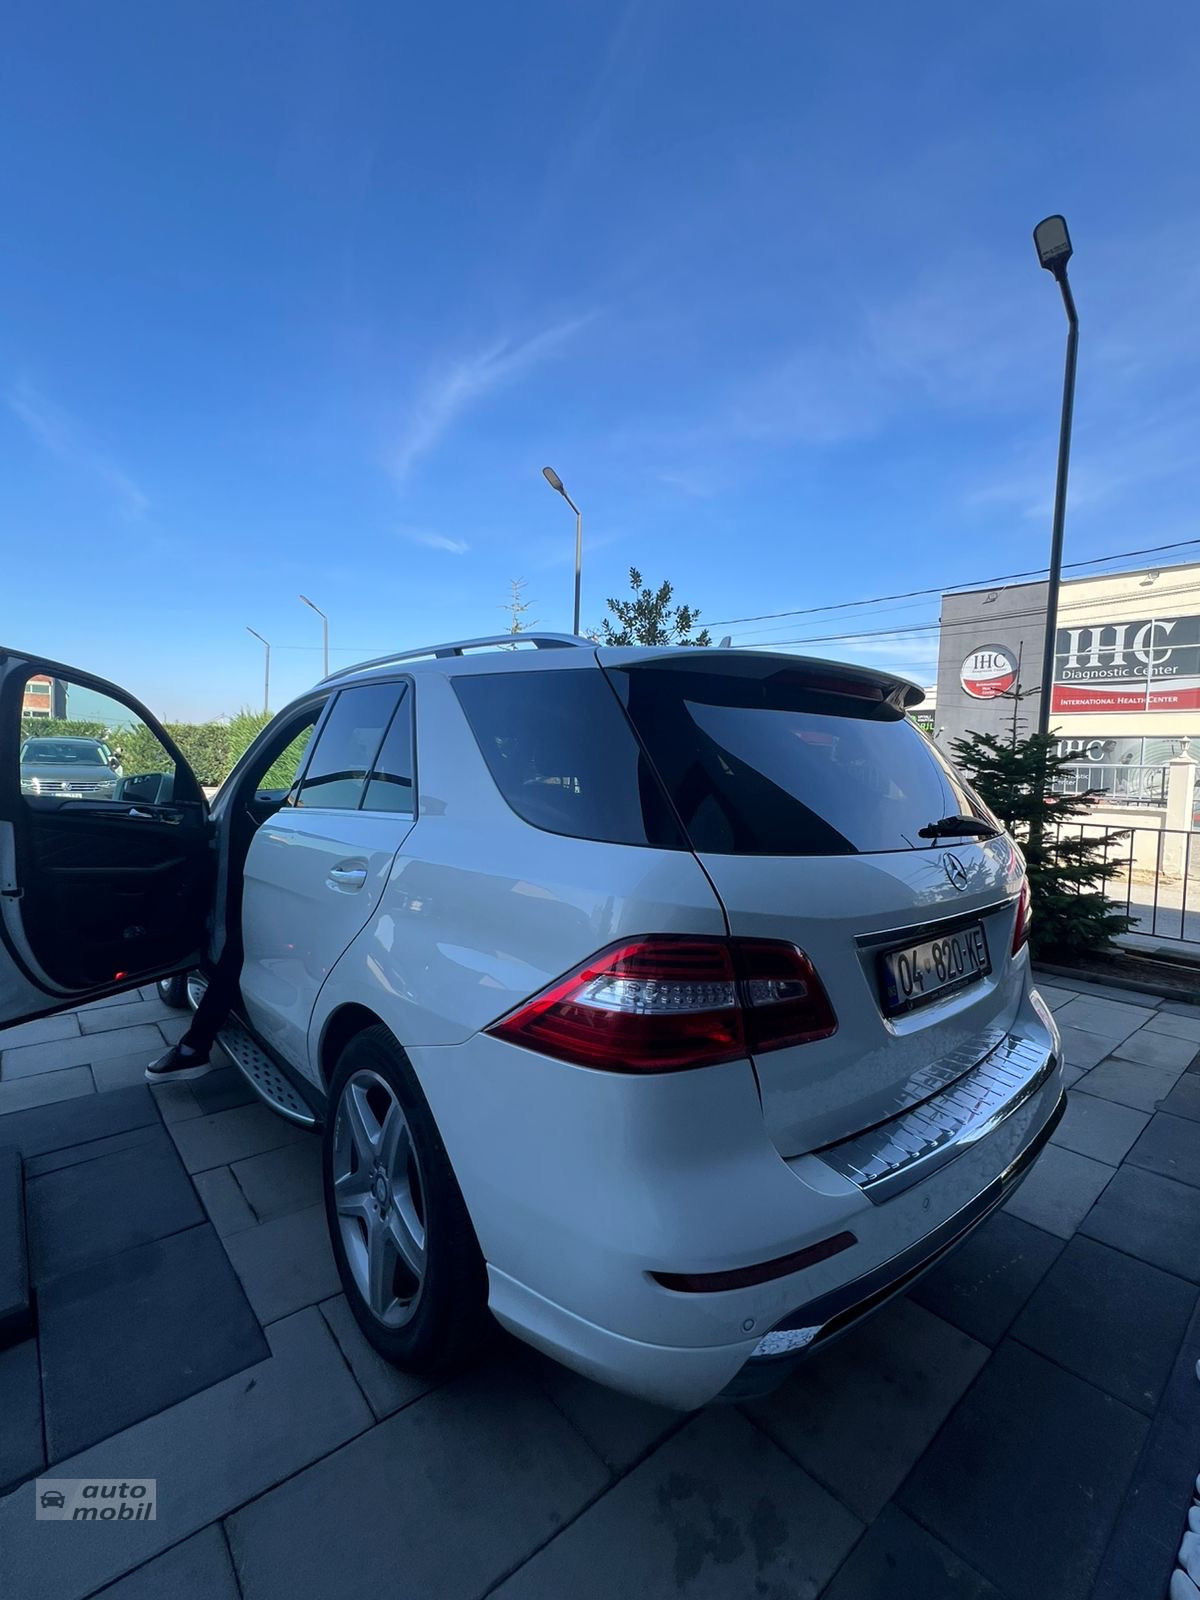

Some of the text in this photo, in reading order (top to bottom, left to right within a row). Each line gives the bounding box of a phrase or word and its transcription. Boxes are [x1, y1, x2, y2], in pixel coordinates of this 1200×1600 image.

[1063, 621, 1177, 669] IHC
[973, 653, 1006, 670] IHC
[1062, 664, 1179, 681] Diagnostic Center
[1060, 698, 1115, 706] INTERNATIONAL
[898, 949, 924, 996] 04
